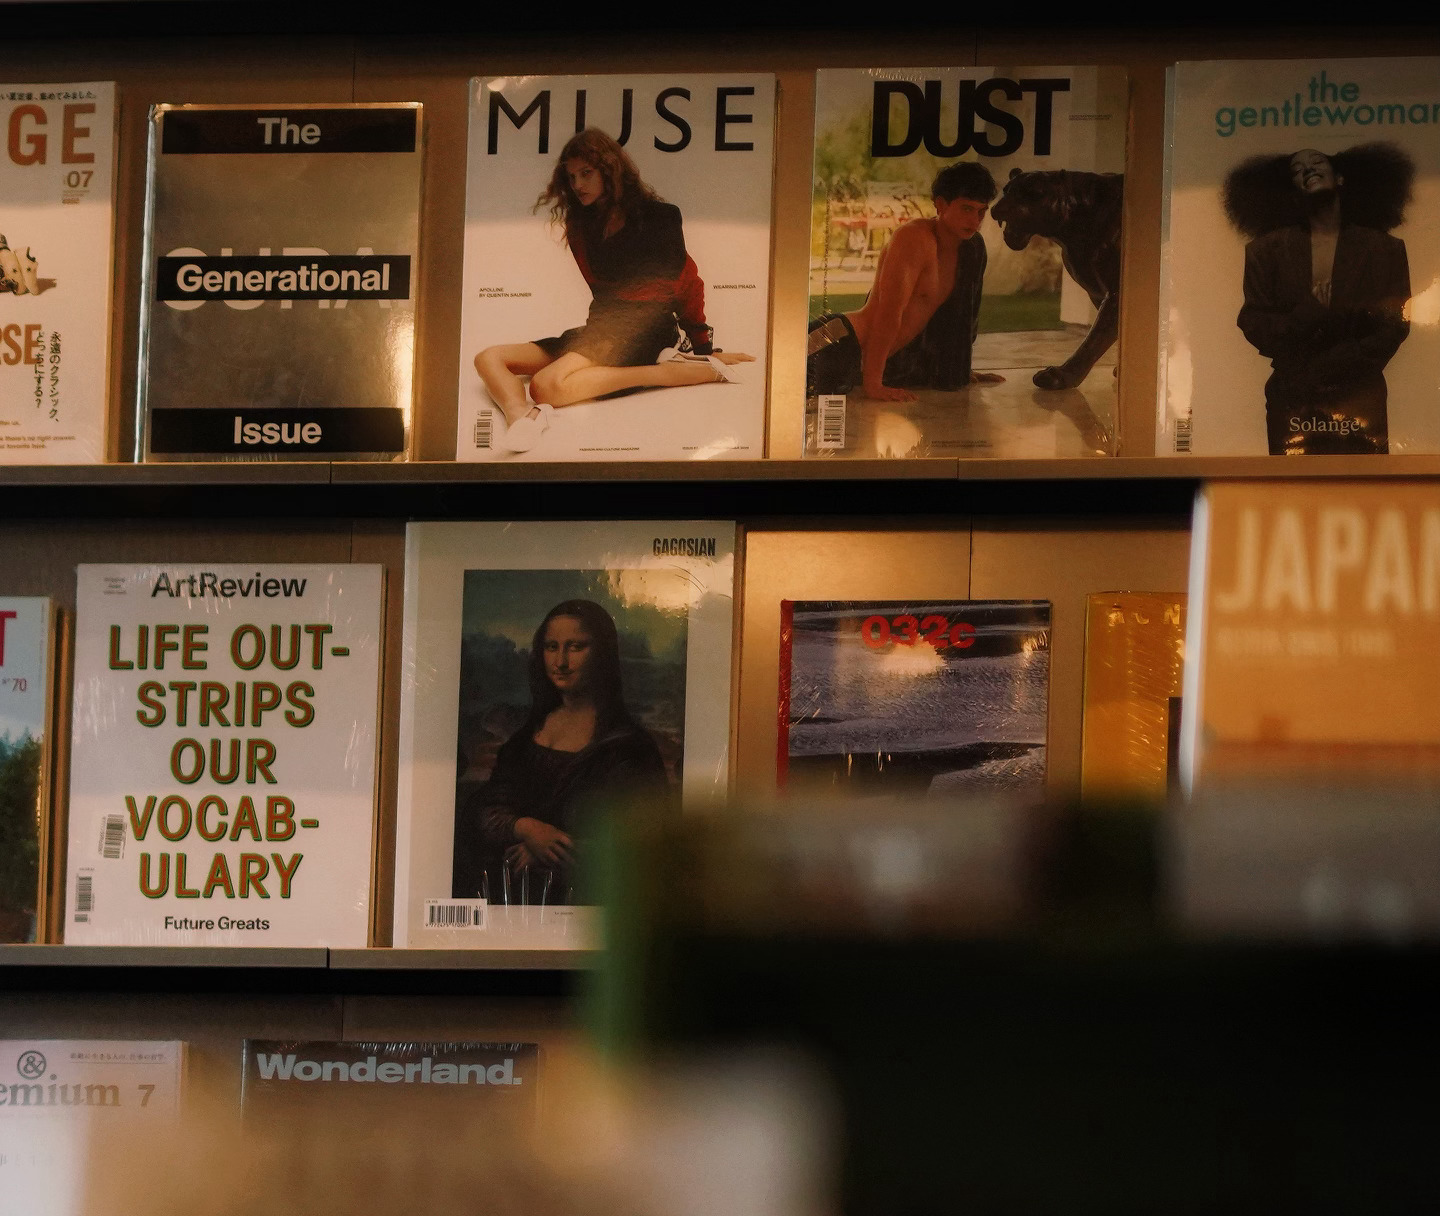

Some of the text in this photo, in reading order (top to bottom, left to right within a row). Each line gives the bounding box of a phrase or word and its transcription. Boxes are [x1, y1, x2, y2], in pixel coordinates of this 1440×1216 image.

[1309, 70, 1361, 103] the
[256, 116, 321, 145] The
[486, 86, 756, 155] MUSE
[871, 77, 1071, 158] DUST
[66, 170, 94, 189] 07
[176, 262, 390, 292] Generational
[233, 415, 322, 444] Issue
[1289, 415, 1361, 435] Solange
[653, 537, 717, 556] GAGOSIAN
[151, 571, 308, 598] ArtReview
[1108, 603, 1181, 627] ACN
[109, 623, 350, 670] LIFE OUT-
[861, 615, 977, 649] 032c
[136, 680, 315, 728] STRIPS
[170, 738, 277, 785] OUR
[125, 794, 319, 842] VOCAB-
[138, 852, 304, 899] ULARY
[164, 916, 270, 930] Future Greats
[257, 1052, 523, 1086] Wonderland.
[137, 1084, 156, 1108] 7
